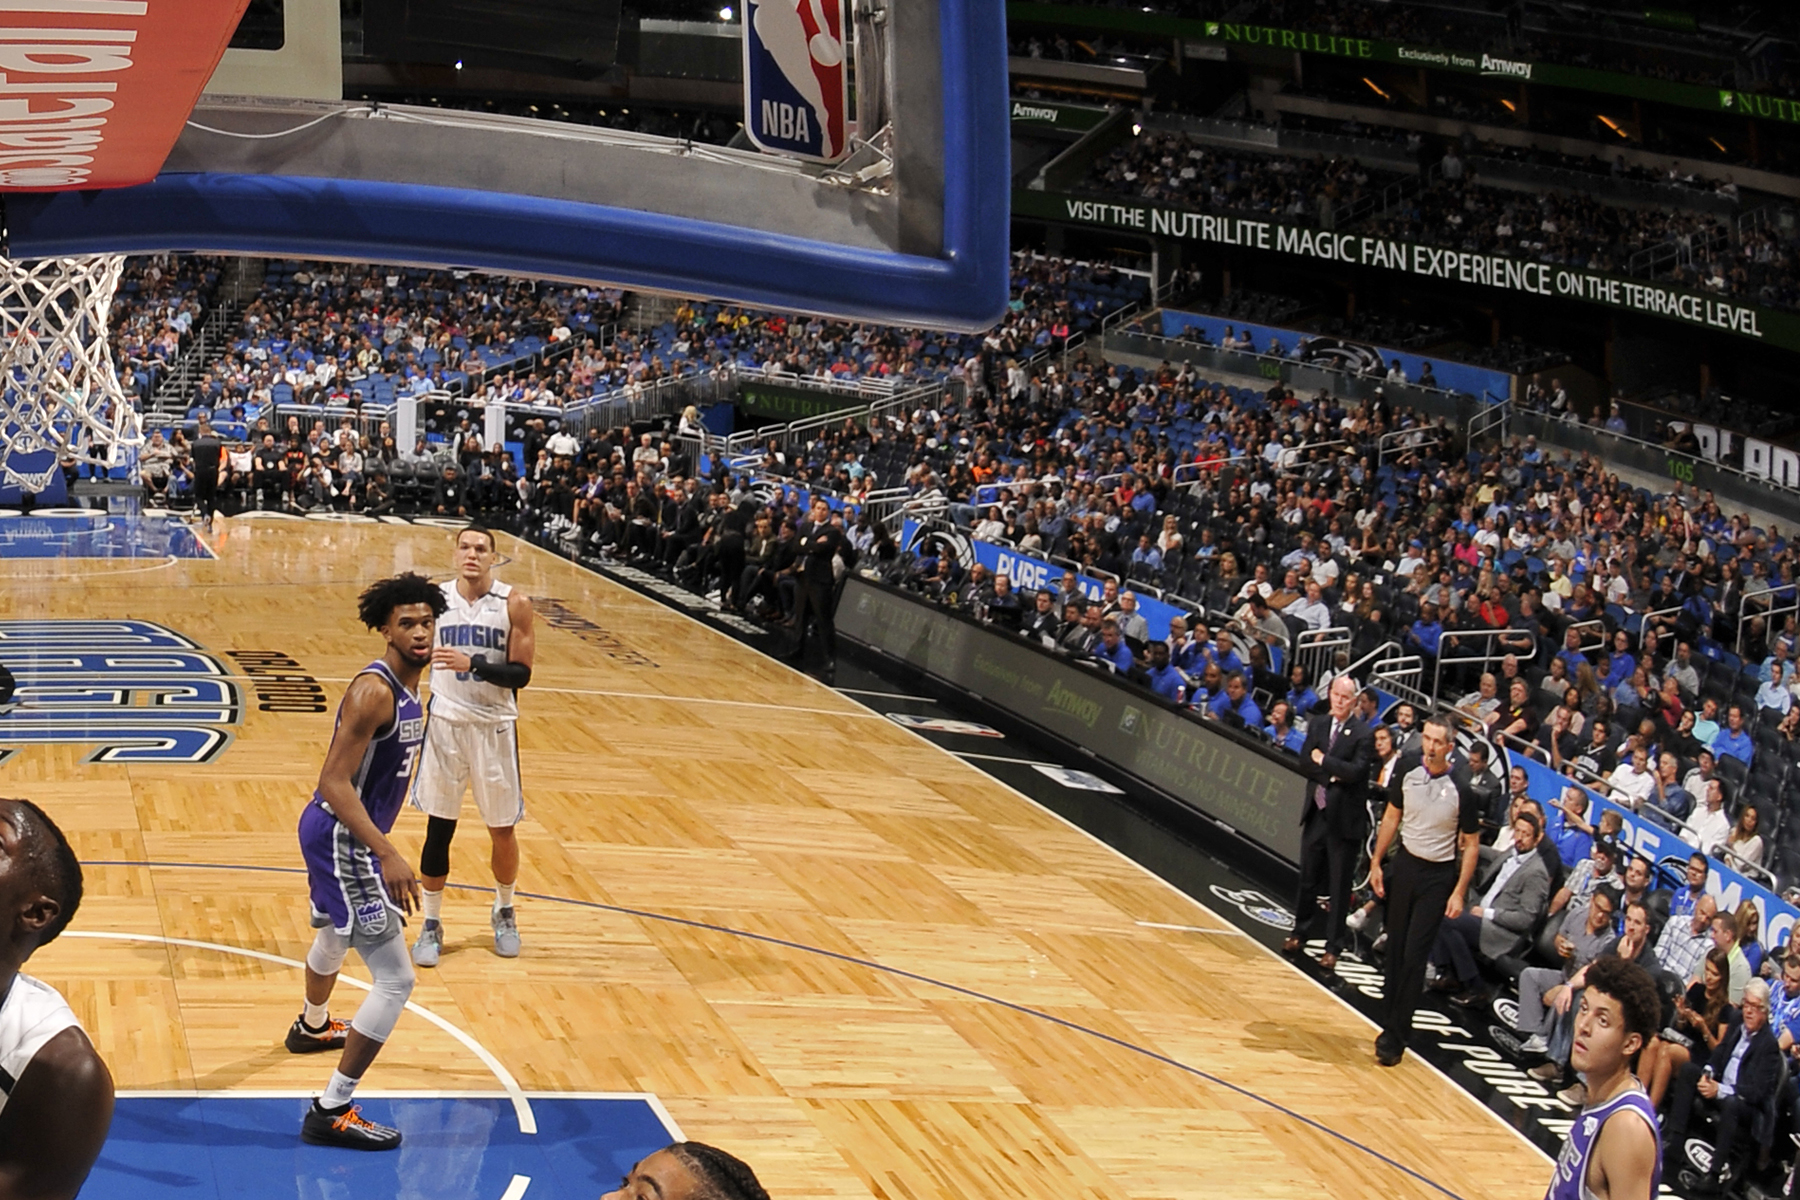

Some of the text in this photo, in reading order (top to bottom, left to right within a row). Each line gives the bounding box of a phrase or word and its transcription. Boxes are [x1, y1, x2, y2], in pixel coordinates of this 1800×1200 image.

[1223, 23, 1373, 59] NUTRILITE
[1398, 47, 1476, 68] Exclusively from
[1480, 53, 1533, 79] Amway
[761, 98, 810, 143] NBA
[1011, 102, 1058, 122] Amway
[1066, 199, 1763, 338] VISIT THE NUTRILITE MAGIC FAN EXPERIENCE ON THE TERRACE LEVEL
[1259, 361, 1281, 379] 104
[1668, 459, 1694, 483] 105
[996, 553, 1048, 589] PURE
[439, 624, 506, 652] MAGIC
[1044, 678, 1103, 729] Amway
[399, 718, 424, 742] SA
[1135, 713, 1285, 807] NUTRILITE
[1411, 1010, 1473, 1038] OF
[1437, 1043, 1574, 1112] PURE
